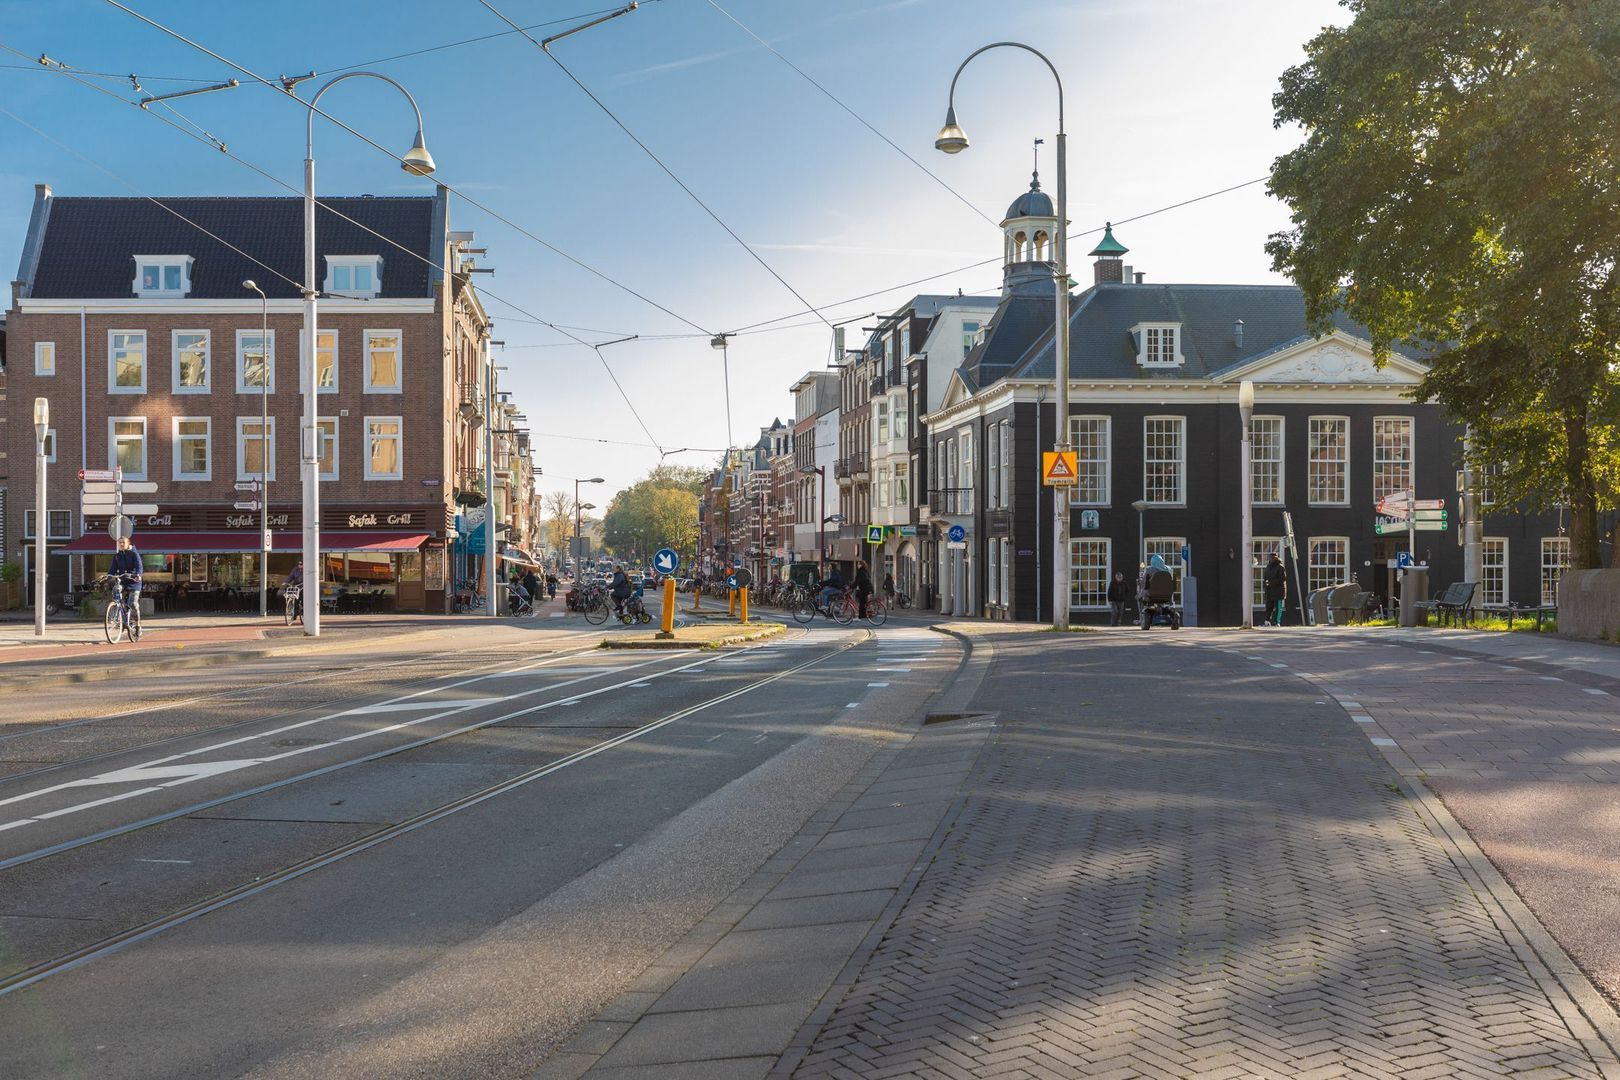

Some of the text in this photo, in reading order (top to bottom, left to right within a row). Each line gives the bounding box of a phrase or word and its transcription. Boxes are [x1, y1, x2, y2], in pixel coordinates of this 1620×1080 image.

[147, 515, 172, 526] Grill
[266, 514, 289, 525] Grill
[387, 513, 411, 525] Grill
[1399, 553, 1407, 563] P
